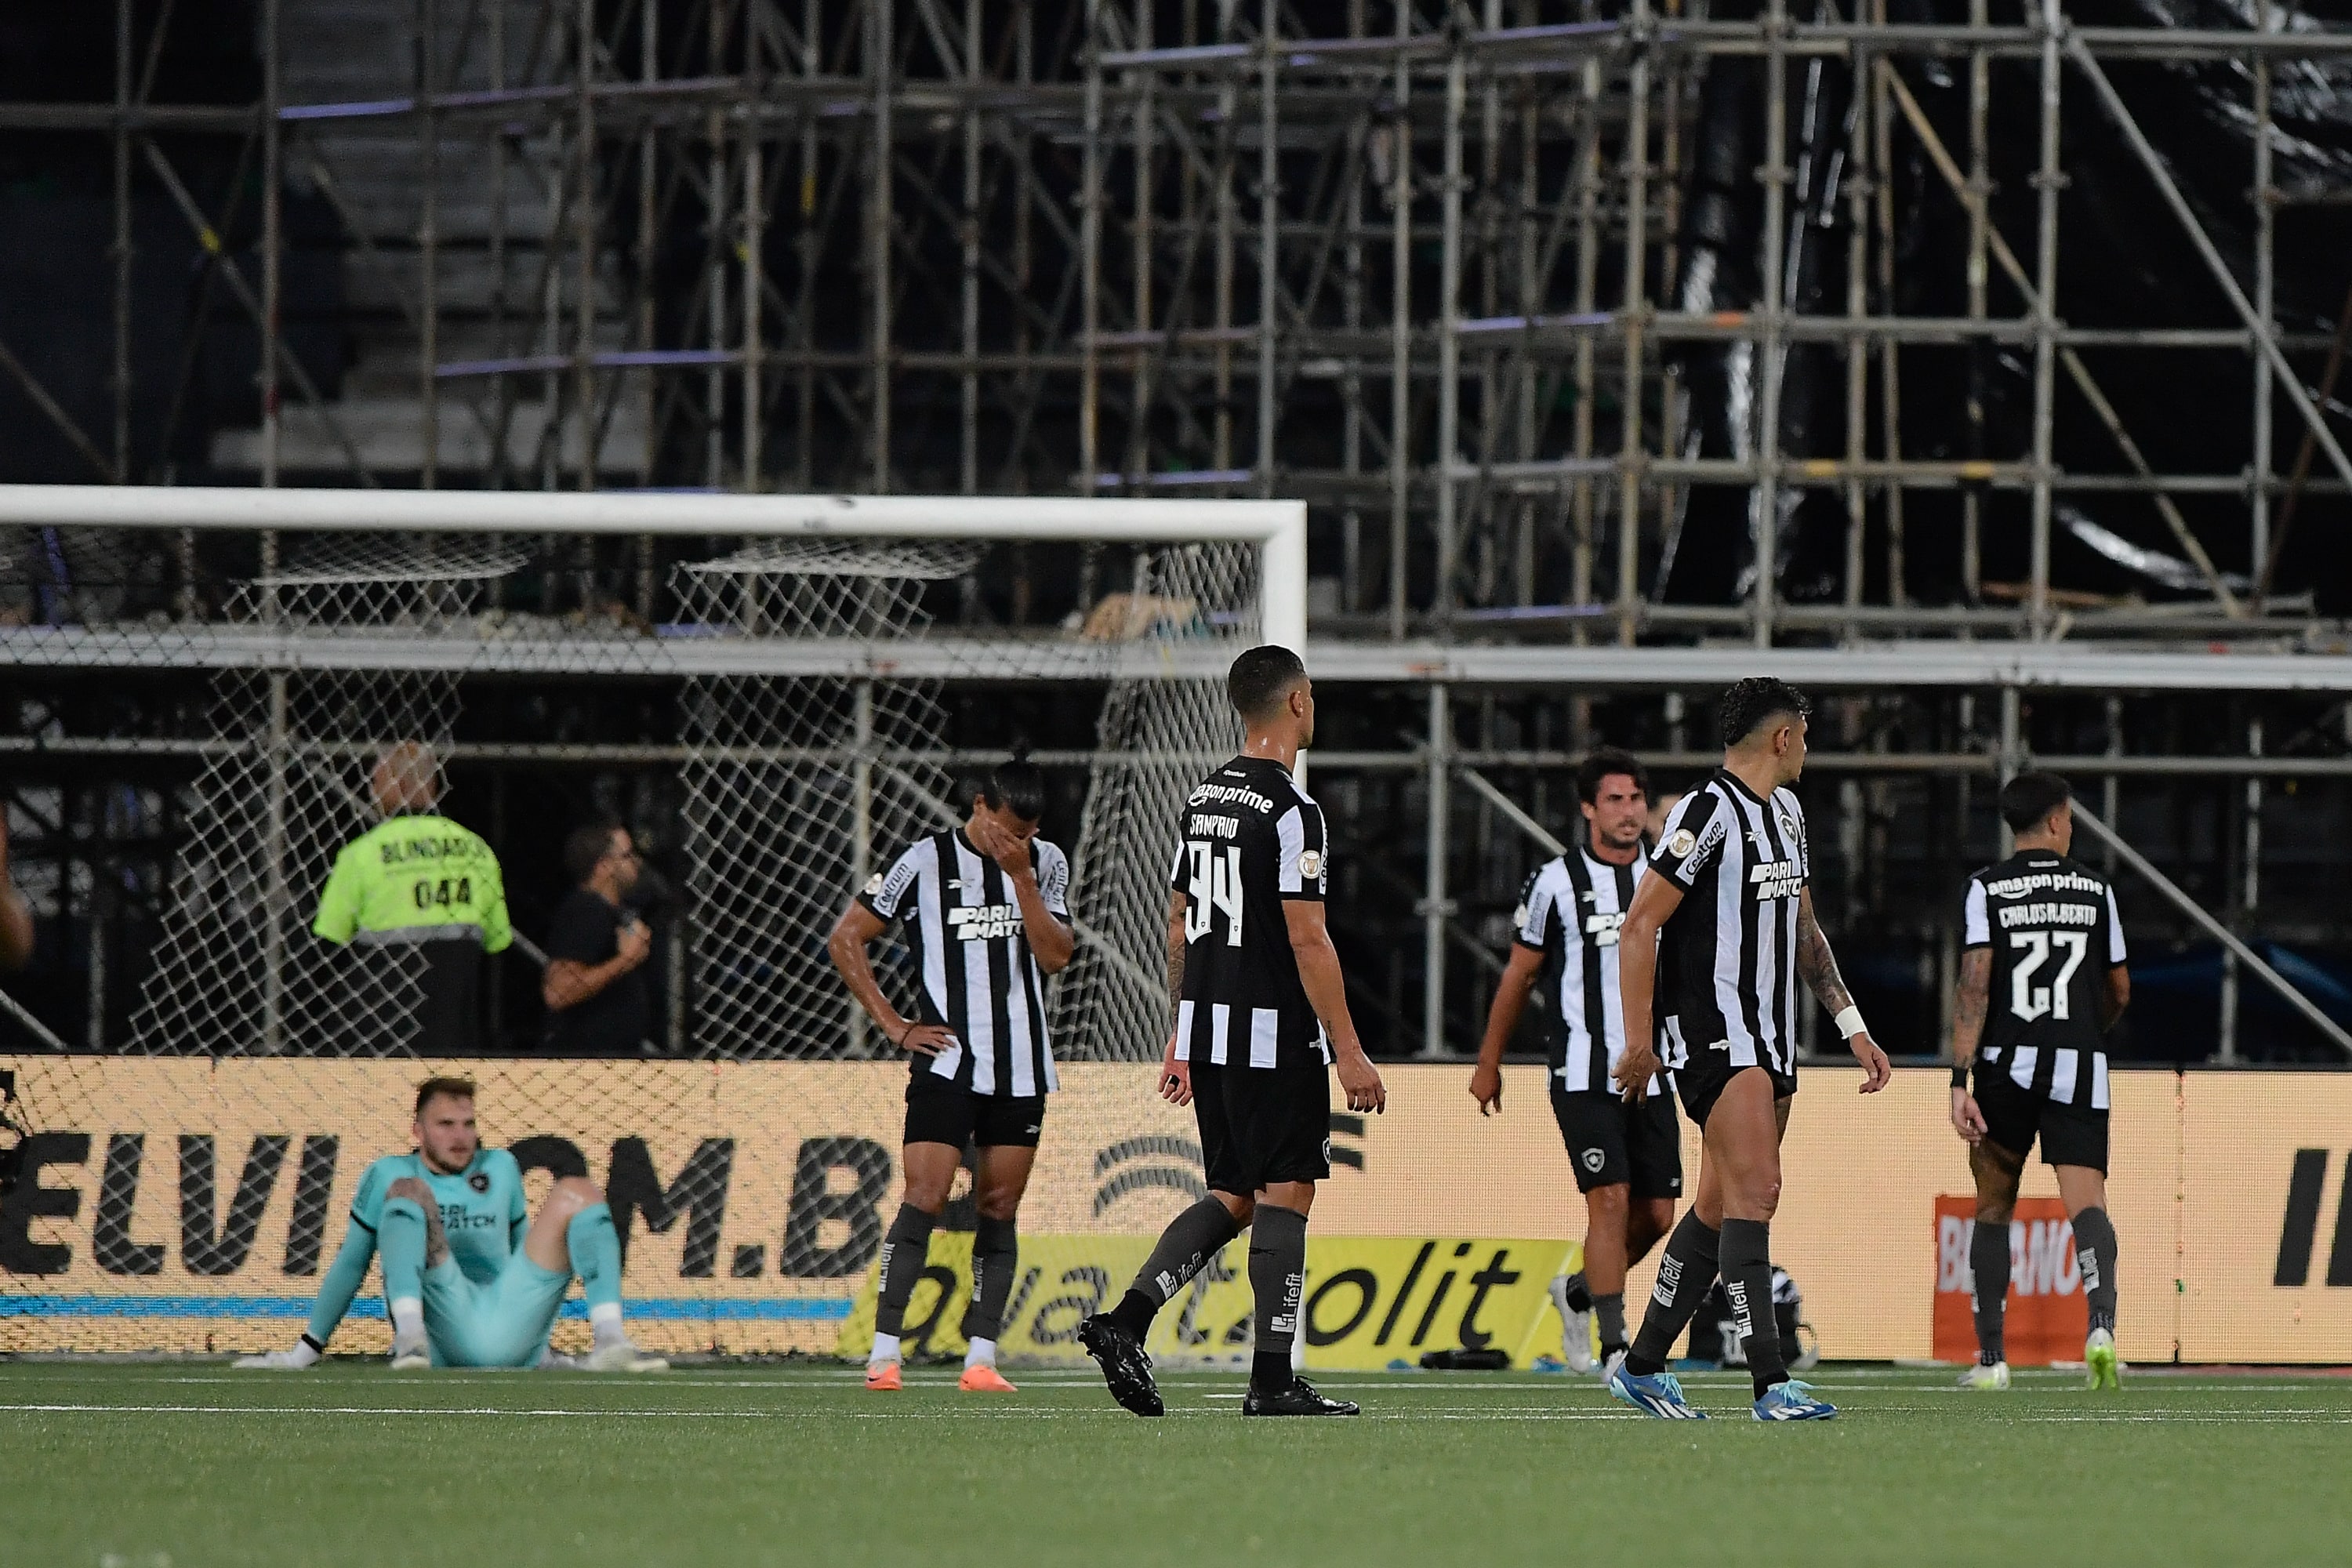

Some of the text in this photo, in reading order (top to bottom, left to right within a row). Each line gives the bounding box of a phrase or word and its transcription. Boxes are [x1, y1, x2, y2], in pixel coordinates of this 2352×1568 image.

[1190, 814, 1240, 840] SAMPAIO
[1758, 861, 1791, 883] PARI
[1185, 841, 1243, 946] 94
[1766, 877, 1802, 900] MATC
[958, 904, 1012, 924] PARI
[967, 920, 1022, 940] MAT
[2009, 931, 2089, 1022] 27
[1938, 1214, 2080, 1297] BANO
